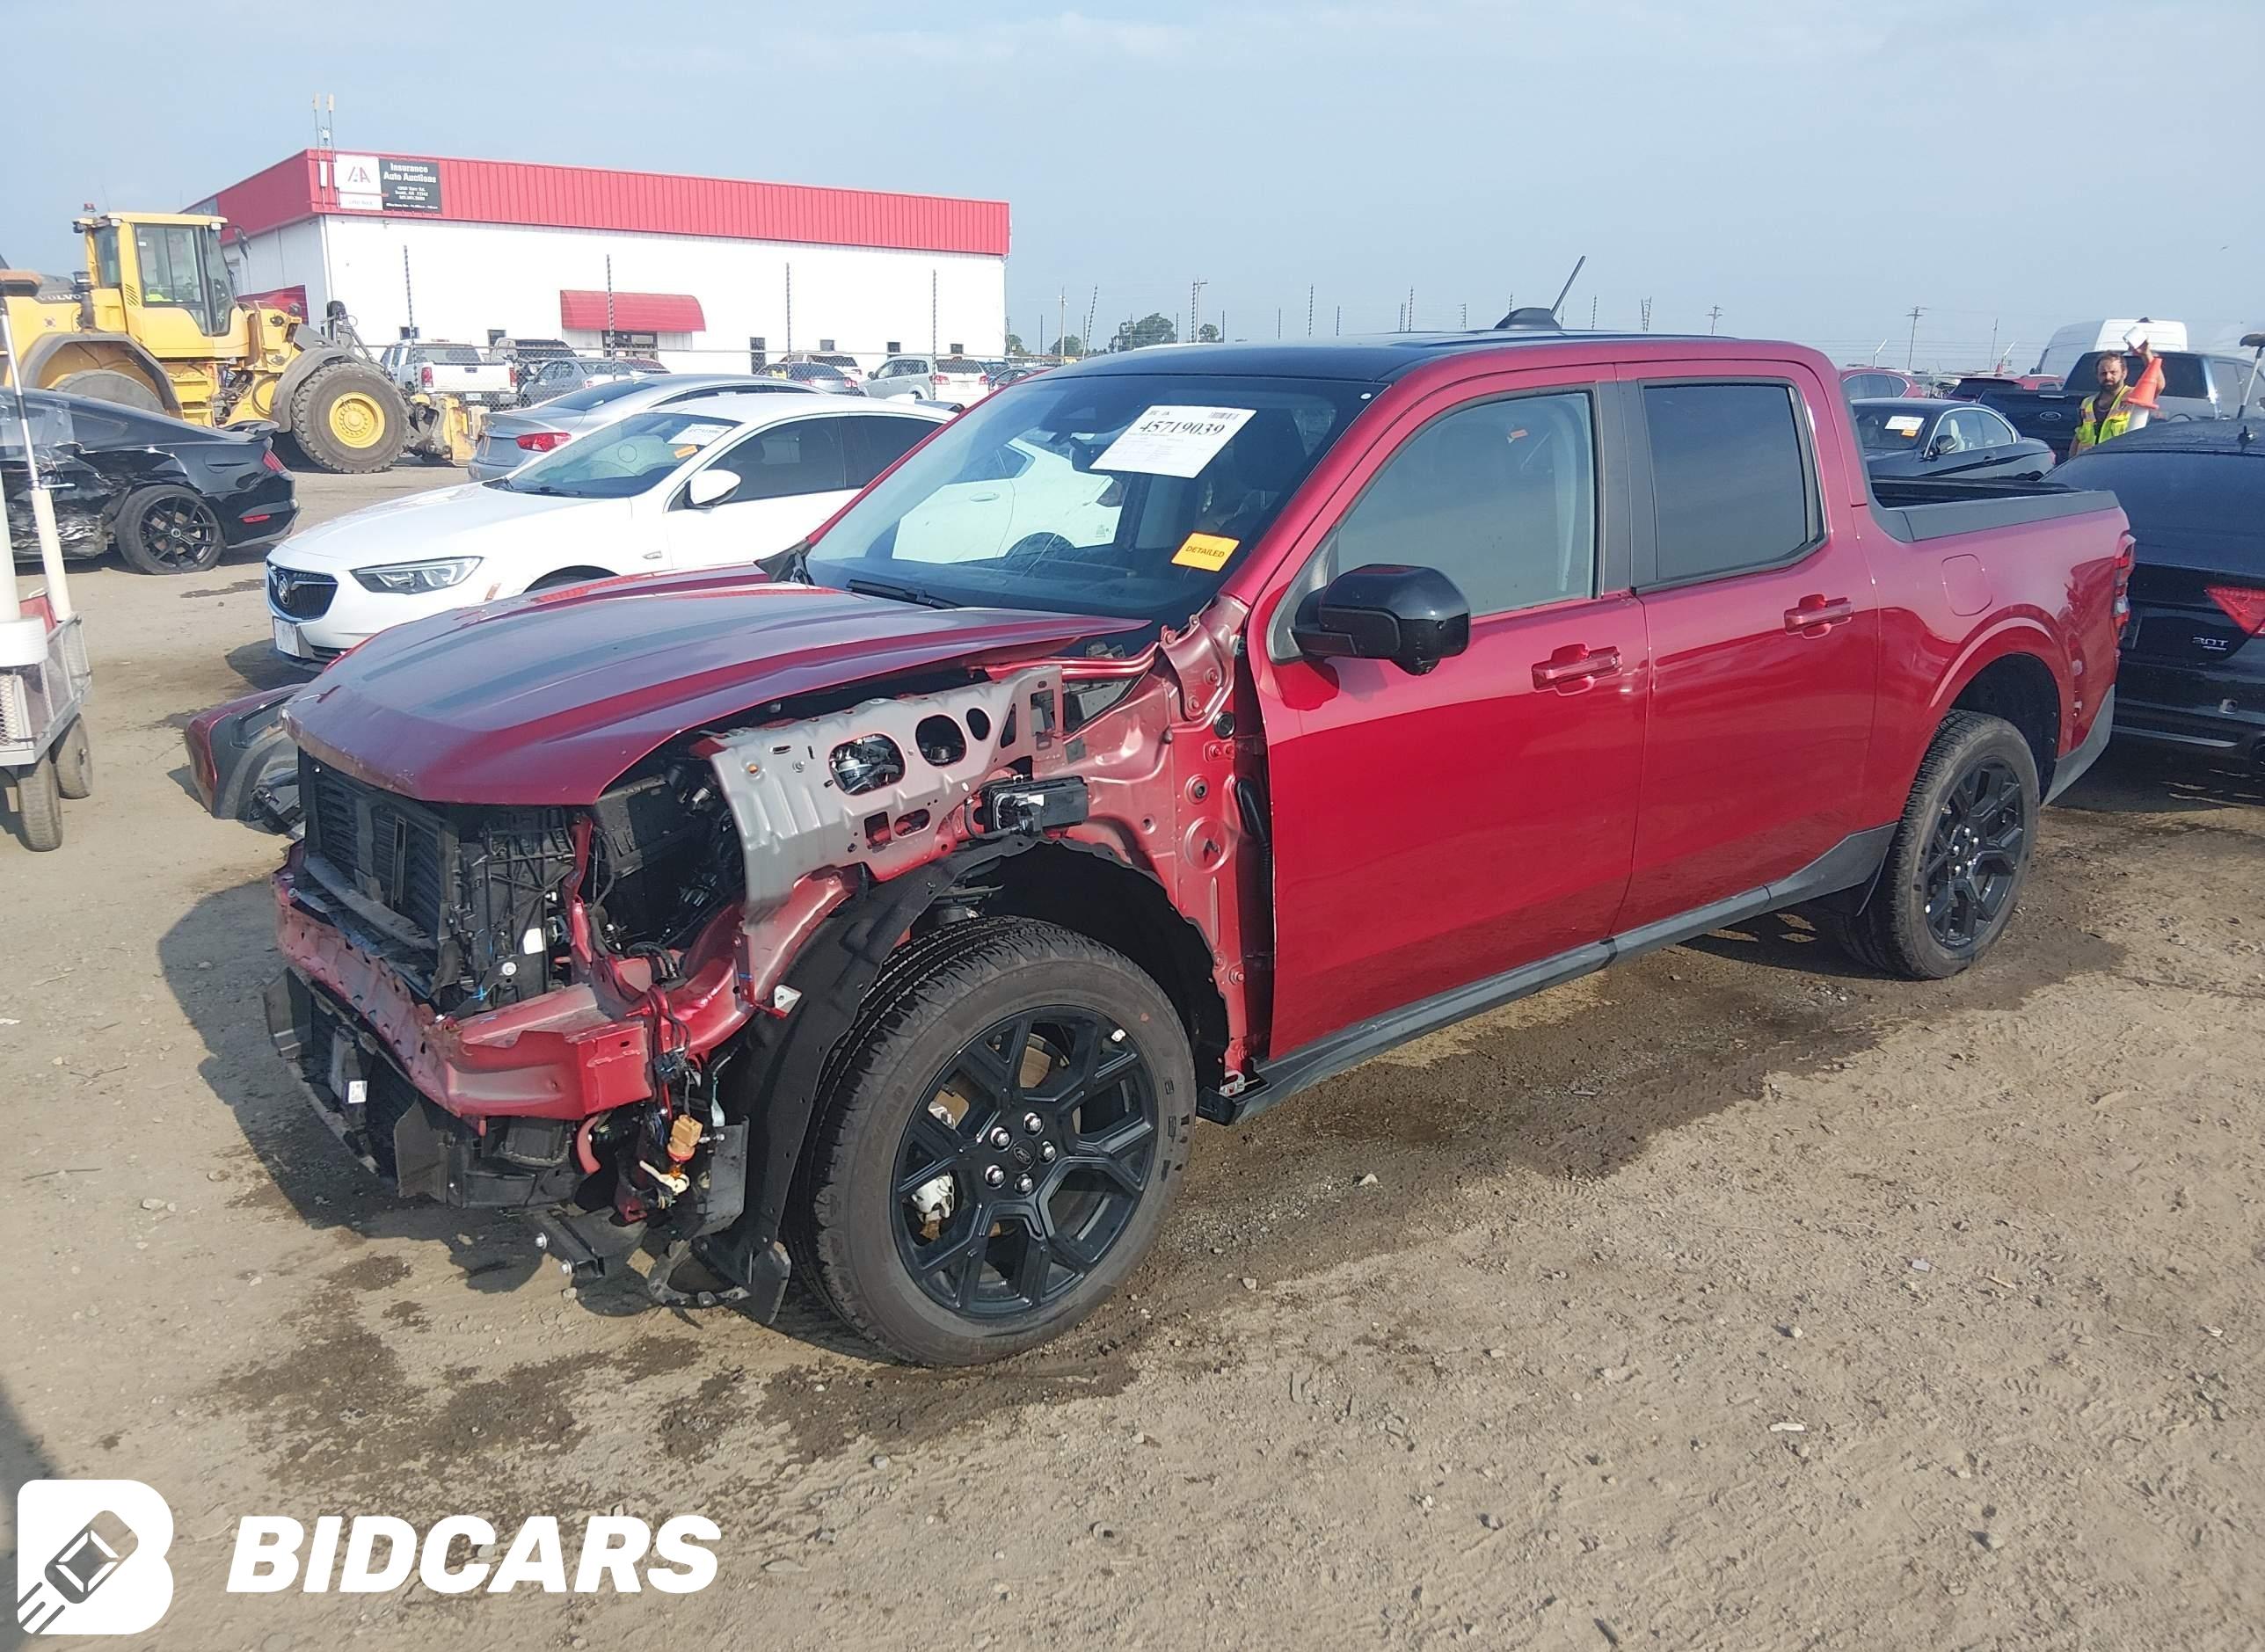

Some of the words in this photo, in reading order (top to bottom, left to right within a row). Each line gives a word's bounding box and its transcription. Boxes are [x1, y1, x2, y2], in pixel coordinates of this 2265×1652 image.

[390, 162, 429, 173] Insurance
[383, 171, 403, 181] Auto
[403, 172, 437, 183] Auctions
[1140, 420, 1226, 436] 45719039
[1185, 545, 1226, 558] DETAILED
